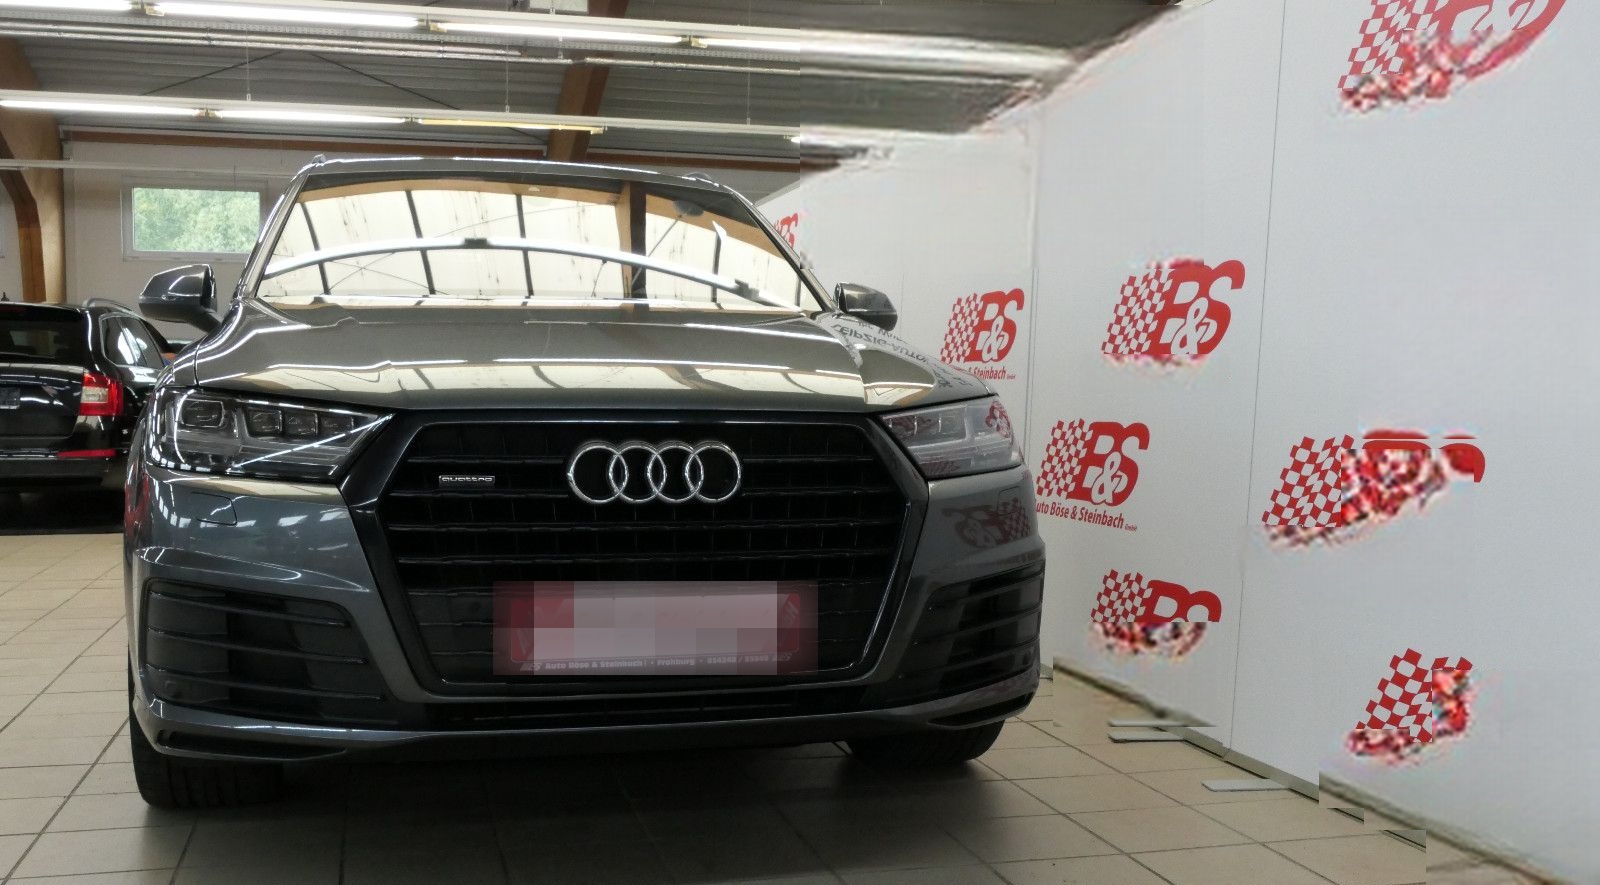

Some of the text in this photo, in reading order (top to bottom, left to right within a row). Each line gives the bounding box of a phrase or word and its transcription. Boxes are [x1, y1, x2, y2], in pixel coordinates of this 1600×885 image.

[1066, 421, 1150, 507] B&S
[441, 476, 493, 484] quattro
[1036, 502, 1049, 514] uto
[1050, 502, 1069, 518] Böse
[1070, 505, 1077, 520] &
[1078, 507, 1124, 529] Steinbach
[545, 662, 566, 670] Auto
[657, 657, 695, 666] Frohburg
